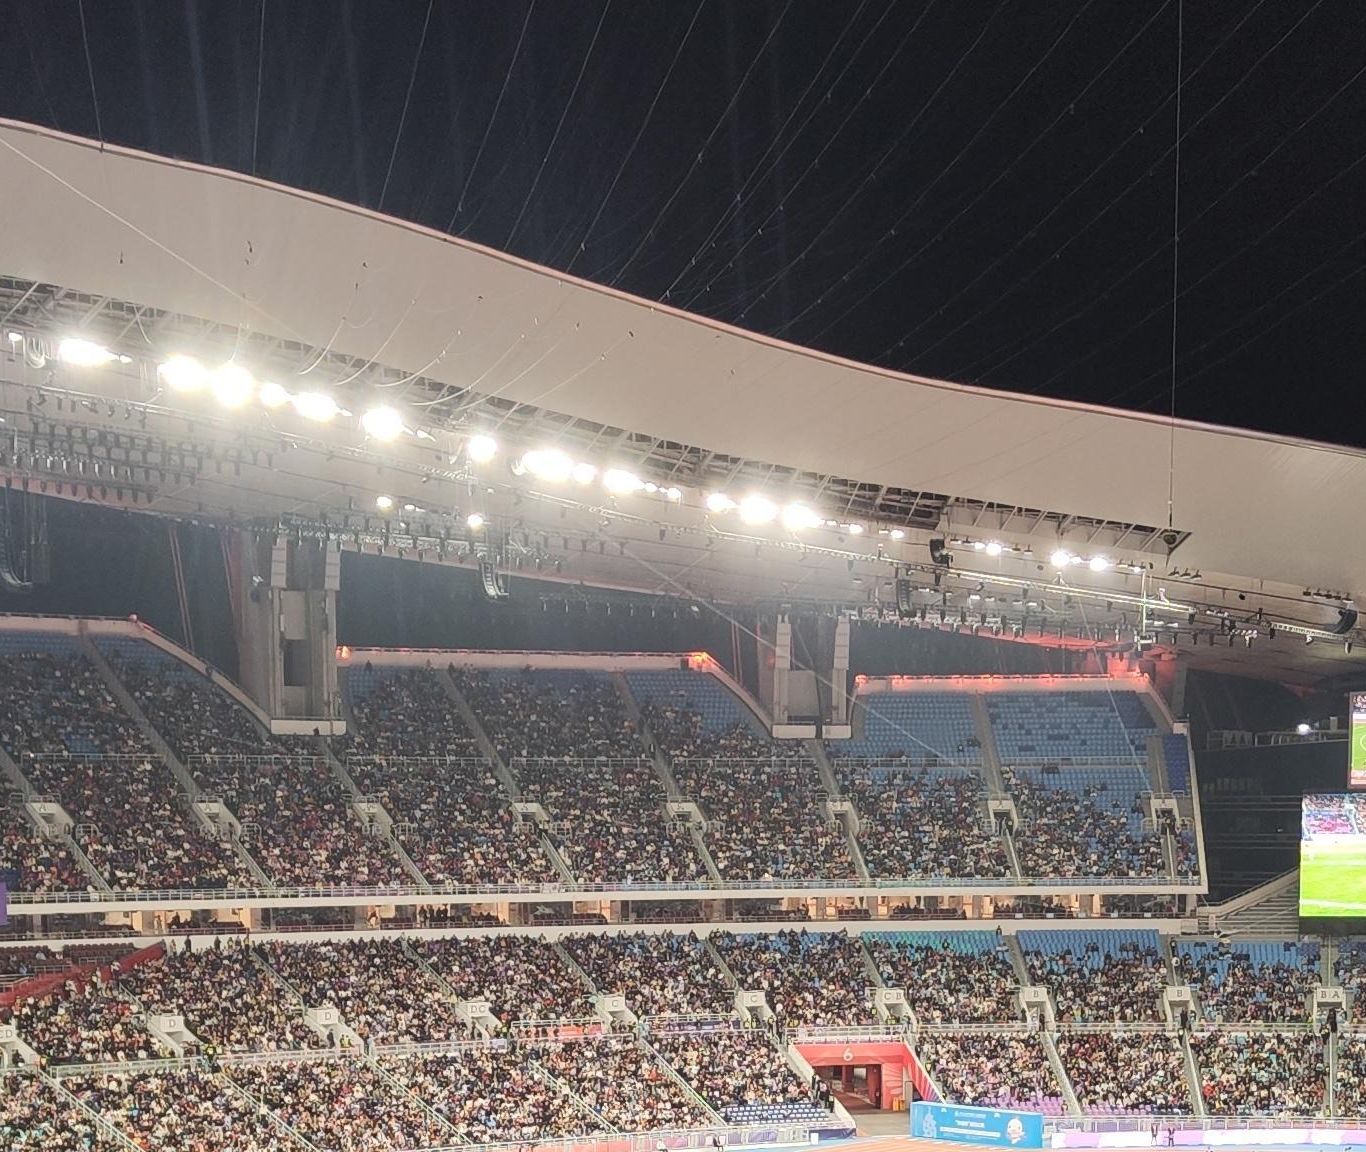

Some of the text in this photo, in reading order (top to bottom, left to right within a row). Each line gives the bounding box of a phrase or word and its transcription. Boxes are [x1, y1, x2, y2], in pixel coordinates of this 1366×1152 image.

[324, 1011, 332, 1020] D
[169, 1019, 176, 1028] D
[842, 1046, 854, 1062] 6
